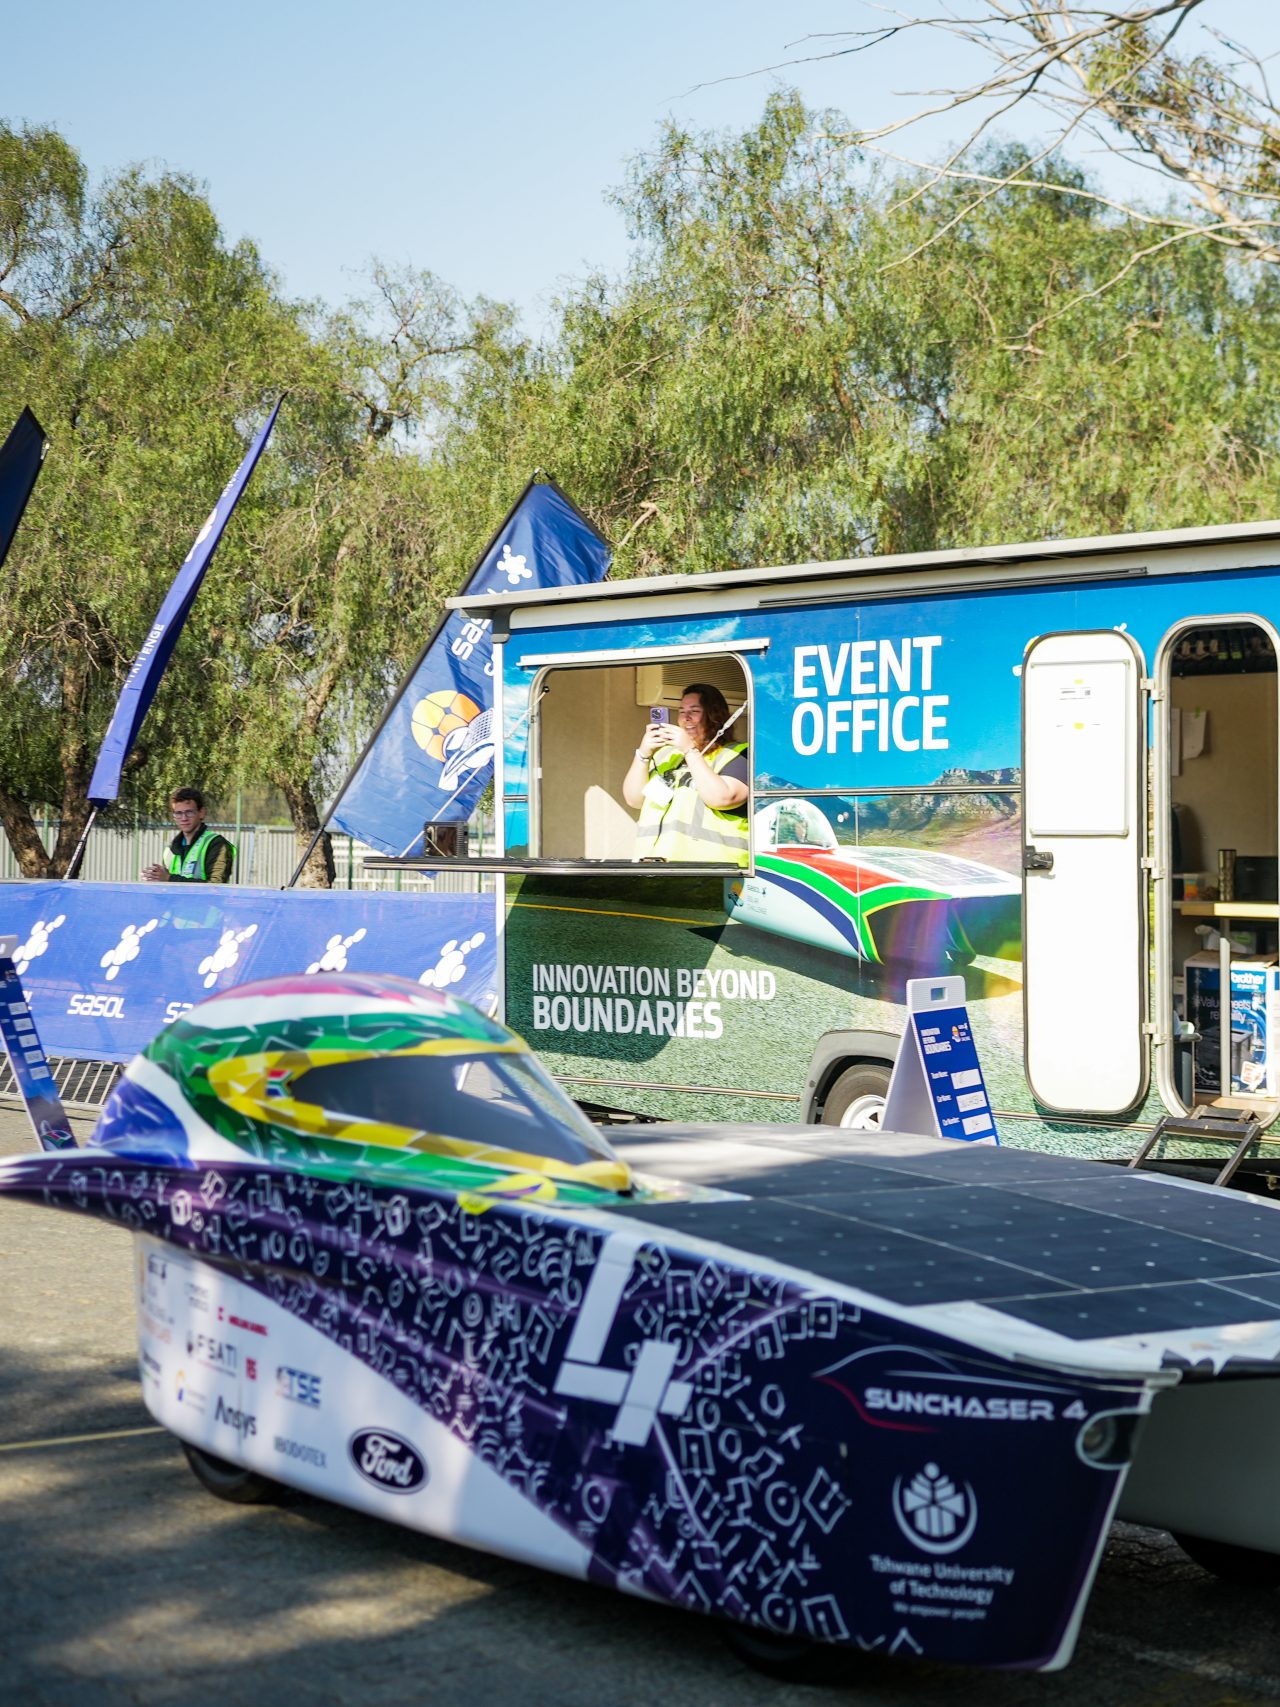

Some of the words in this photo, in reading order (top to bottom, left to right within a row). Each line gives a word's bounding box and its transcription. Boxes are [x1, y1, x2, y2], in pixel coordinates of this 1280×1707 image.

[793, 635, 942, 698] EVENT
[791, 695, 949, 756] OFFICE
[532, 963, 671, 996] INNOVATION
[676, 968, 776, 1000] BEYOND
[532, 995, 724, 1039] BOUNDARIES
[864, 1387, 1056, 1421] SUNCHASER
[1061, 1399, 1089, 1420] 4
[360, 1434, 415, 1487] Ford
[869, 1553, 932, 1578] Tshwane
[933, 1561, 1015, 1586] University
[889, 1578, 907, 1596] of
[907, 1580, 995, 1606] Technology
